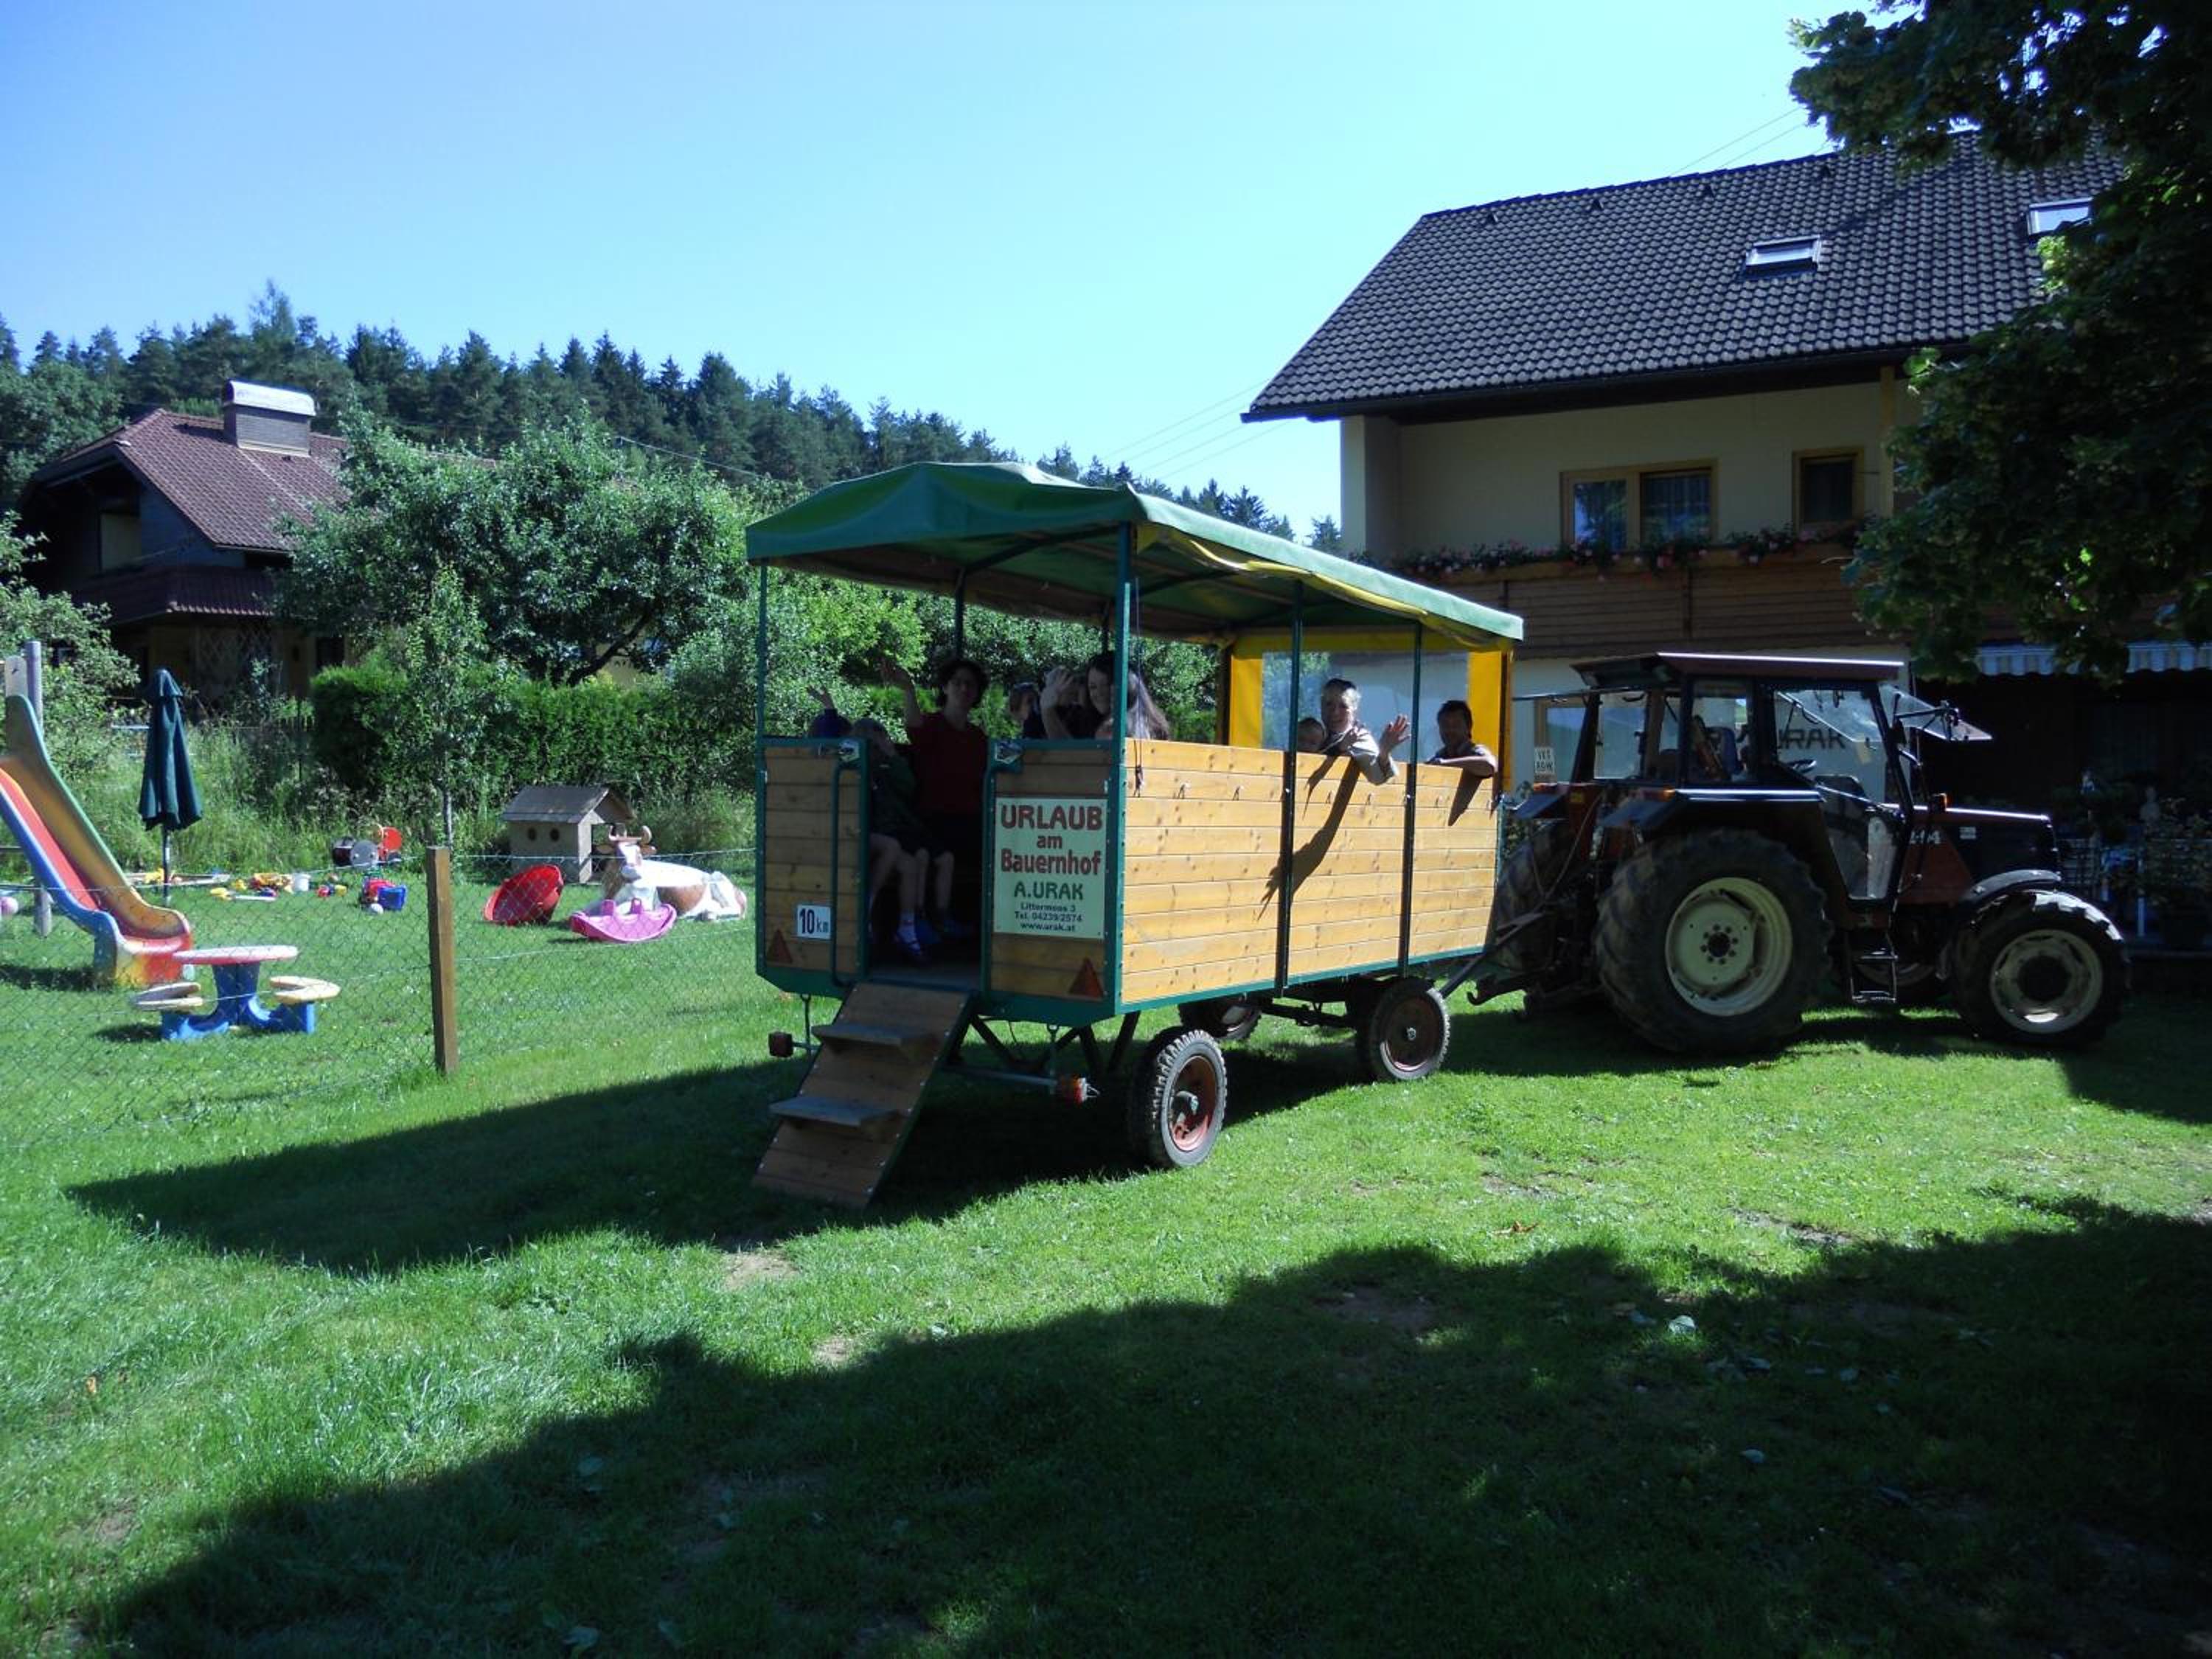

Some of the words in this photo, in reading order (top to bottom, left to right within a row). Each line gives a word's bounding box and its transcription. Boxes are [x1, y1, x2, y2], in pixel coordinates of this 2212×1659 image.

[1001, 804, 1103, 830] URLAUB
[1037, 835, 1062, 849] am
[1001, 849, 1102, 875] Bauernhof
[1014, 881, 1083, 900] A.URAK
[799, 908, 815, 934] 10
[816, 916, 829, 933] km
[1020, 923, 1075, 931] www.urak.at
